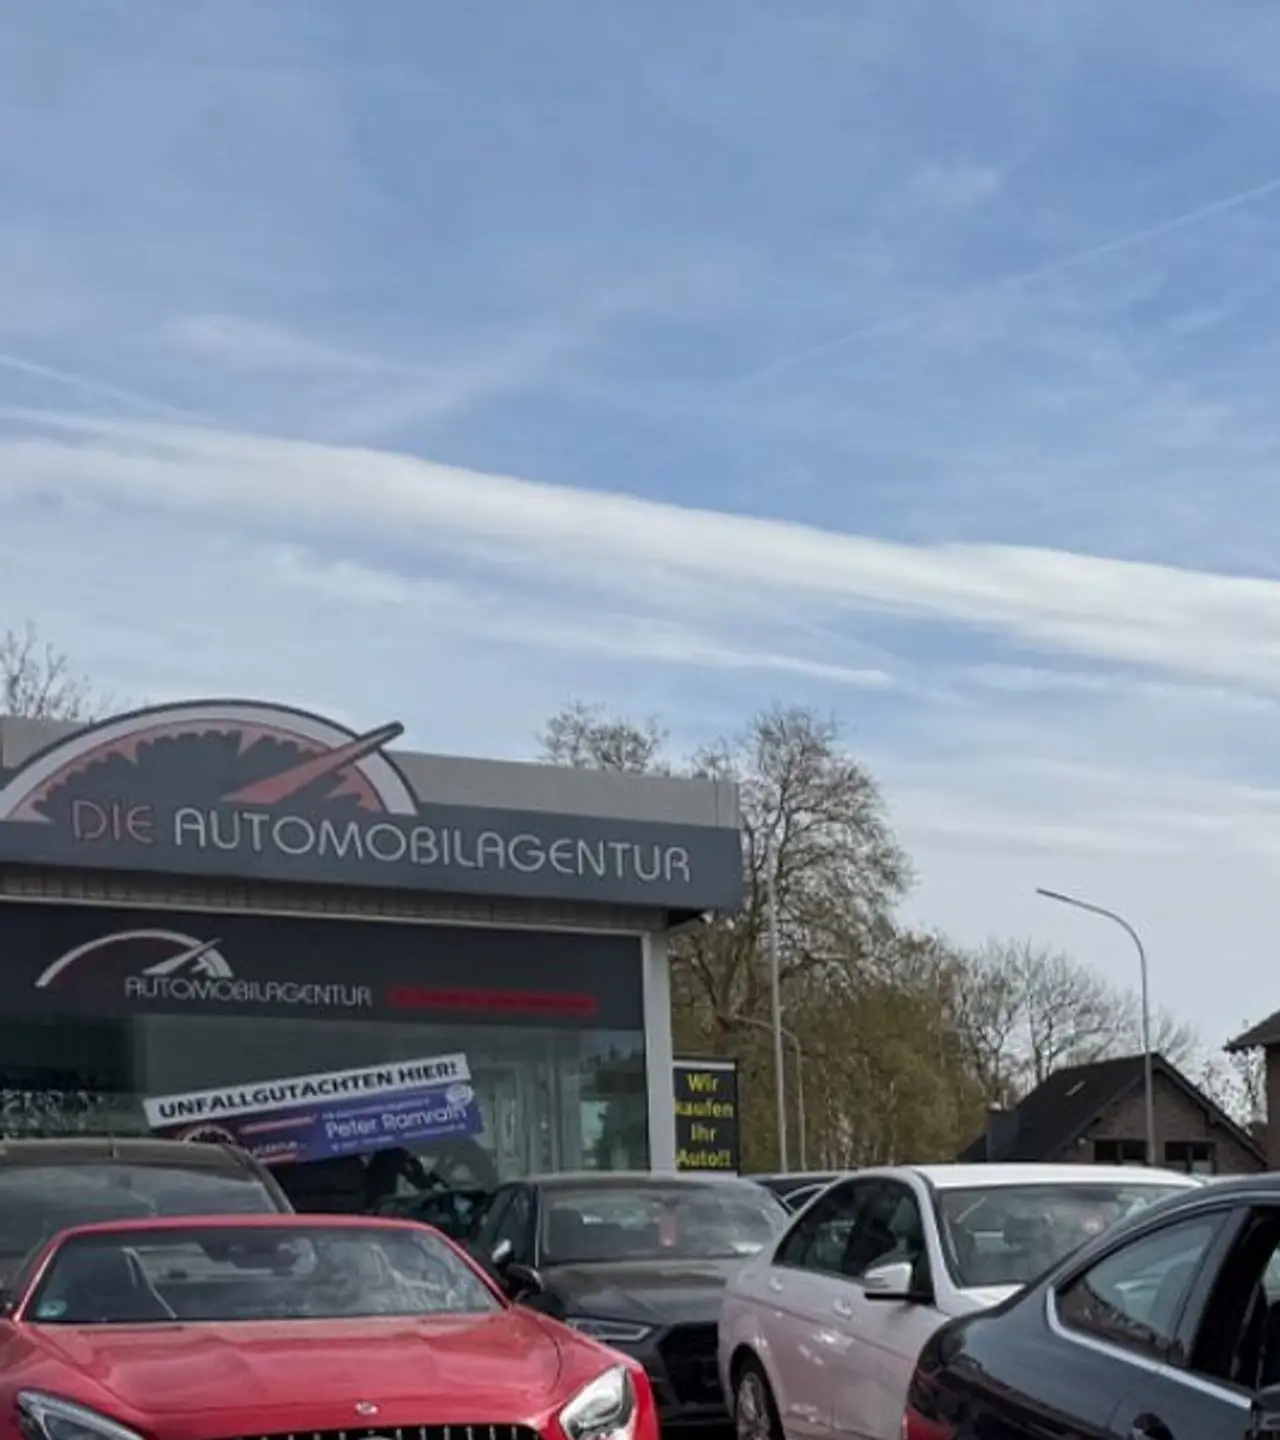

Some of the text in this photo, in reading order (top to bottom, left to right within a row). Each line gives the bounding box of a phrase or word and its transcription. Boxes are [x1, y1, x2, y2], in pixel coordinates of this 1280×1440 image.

[72, 799, 691, 883] DIE AUTOMOBILAGENTUR
[125, 976, 372, 1006] AUTOMOBILAGENTUR
[158, 1070, 395, 1119] UNFALLGUTACHTEN
[398, 1060, 458, 1083] HIER!
[686, 1072, 719, 1092] Wir
[325, 1114, 379, 1138] Peter
[690, 1122, 717, 1142] Ihr
